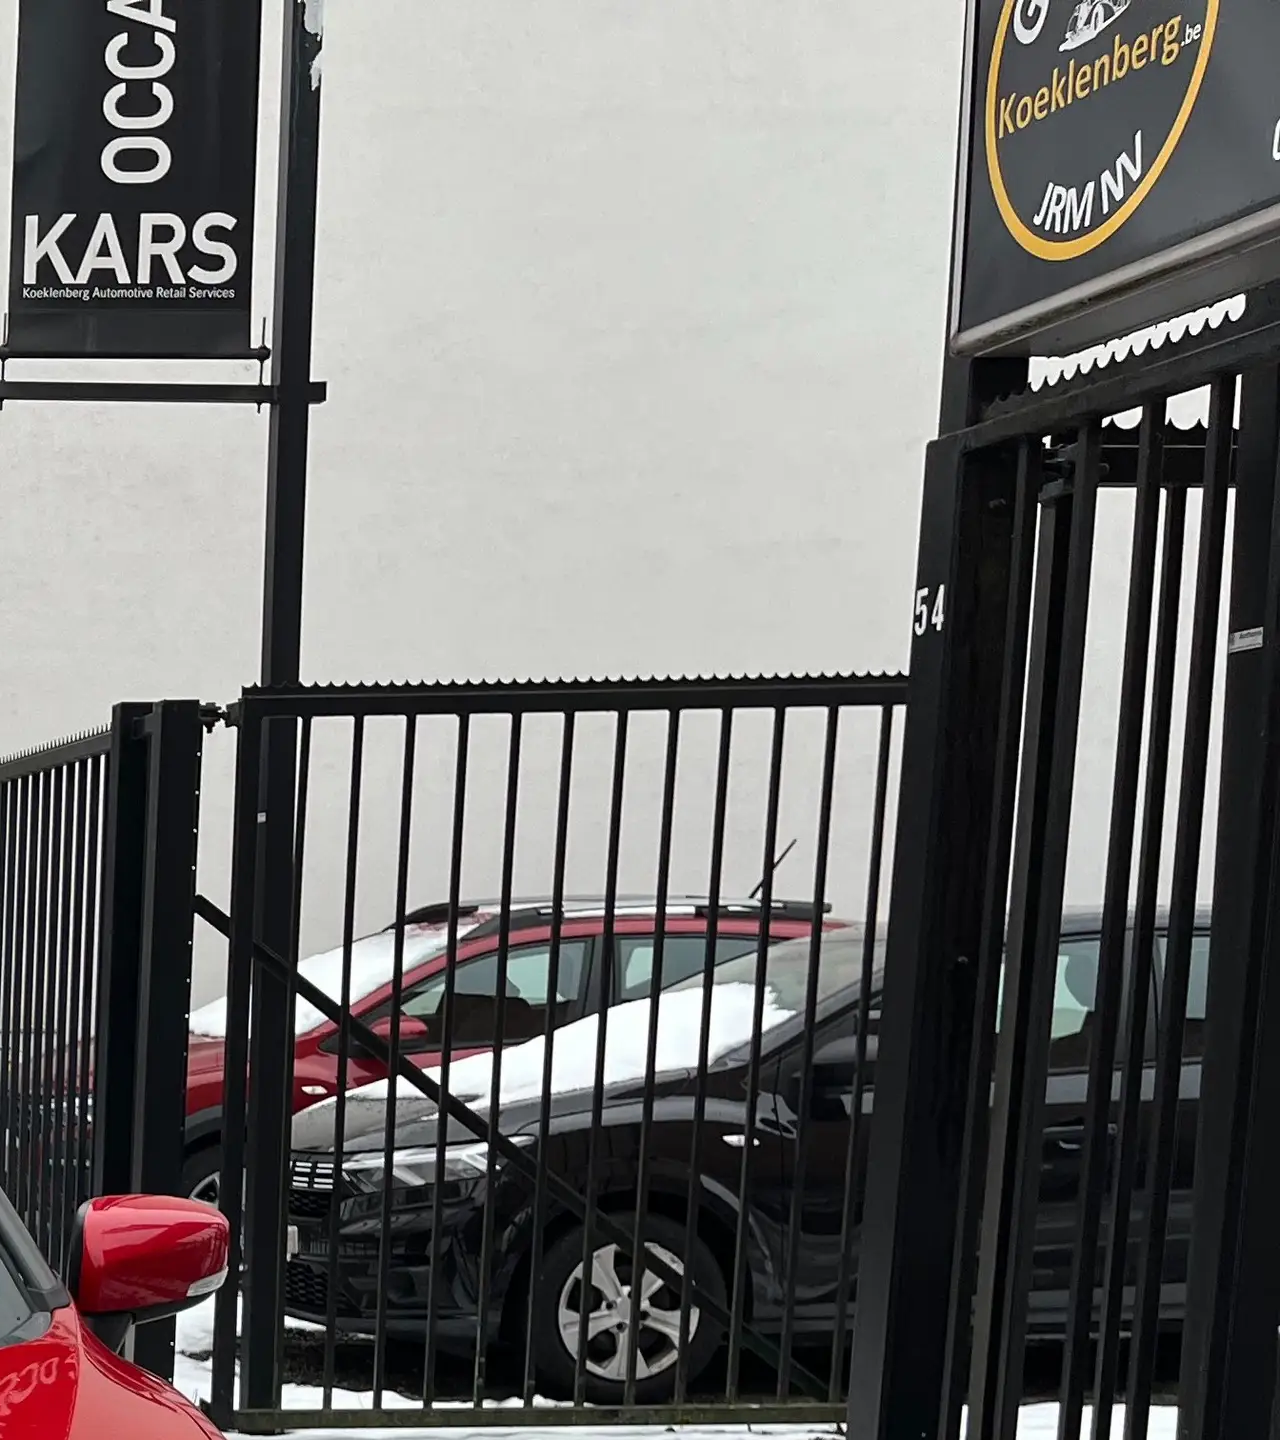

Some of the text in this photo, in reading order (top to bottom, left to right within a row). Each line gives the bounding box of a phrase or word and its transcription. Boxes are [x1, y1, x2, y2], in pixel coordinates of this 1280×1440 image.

[1033, 129, 1142, 233] JRM NV
[23, 212, 238, 285] KARS
[22, 286, 235, 301] Koeklenberg Automotive Retail Services
[914, 584, 945, 636] 54
